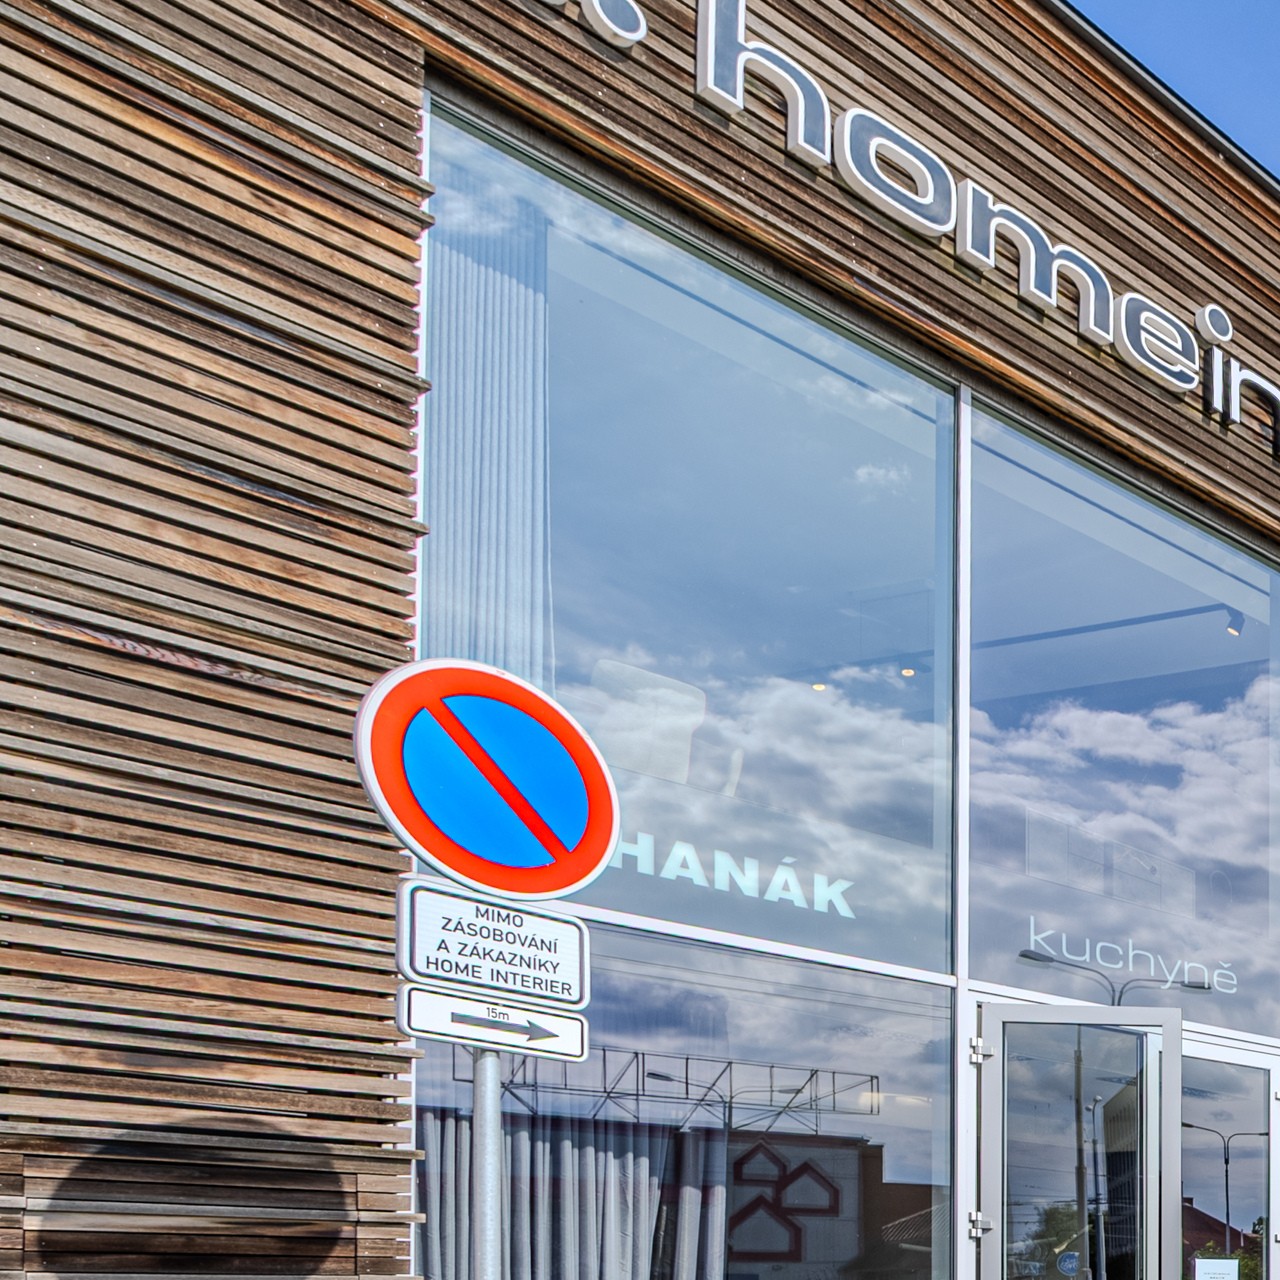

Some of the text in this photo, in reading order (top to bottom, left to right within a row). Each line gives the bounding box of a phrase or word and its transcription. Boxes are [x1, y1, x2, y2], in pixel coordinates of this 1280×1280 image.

[608, 826, 857, 919] HANÁK
[441, 916, 559, 954] ZÁSOBOVÁNÍ
[475, 905, 524, 928] MIMO
[437, 939, 560, 974] A ZÁKAZNÍKY
[1029, 915, 1238, 994] kuchyně
[426, 956, 573, 996] HOME INTERIER
[486, 1007, 510, 1021] 15m
